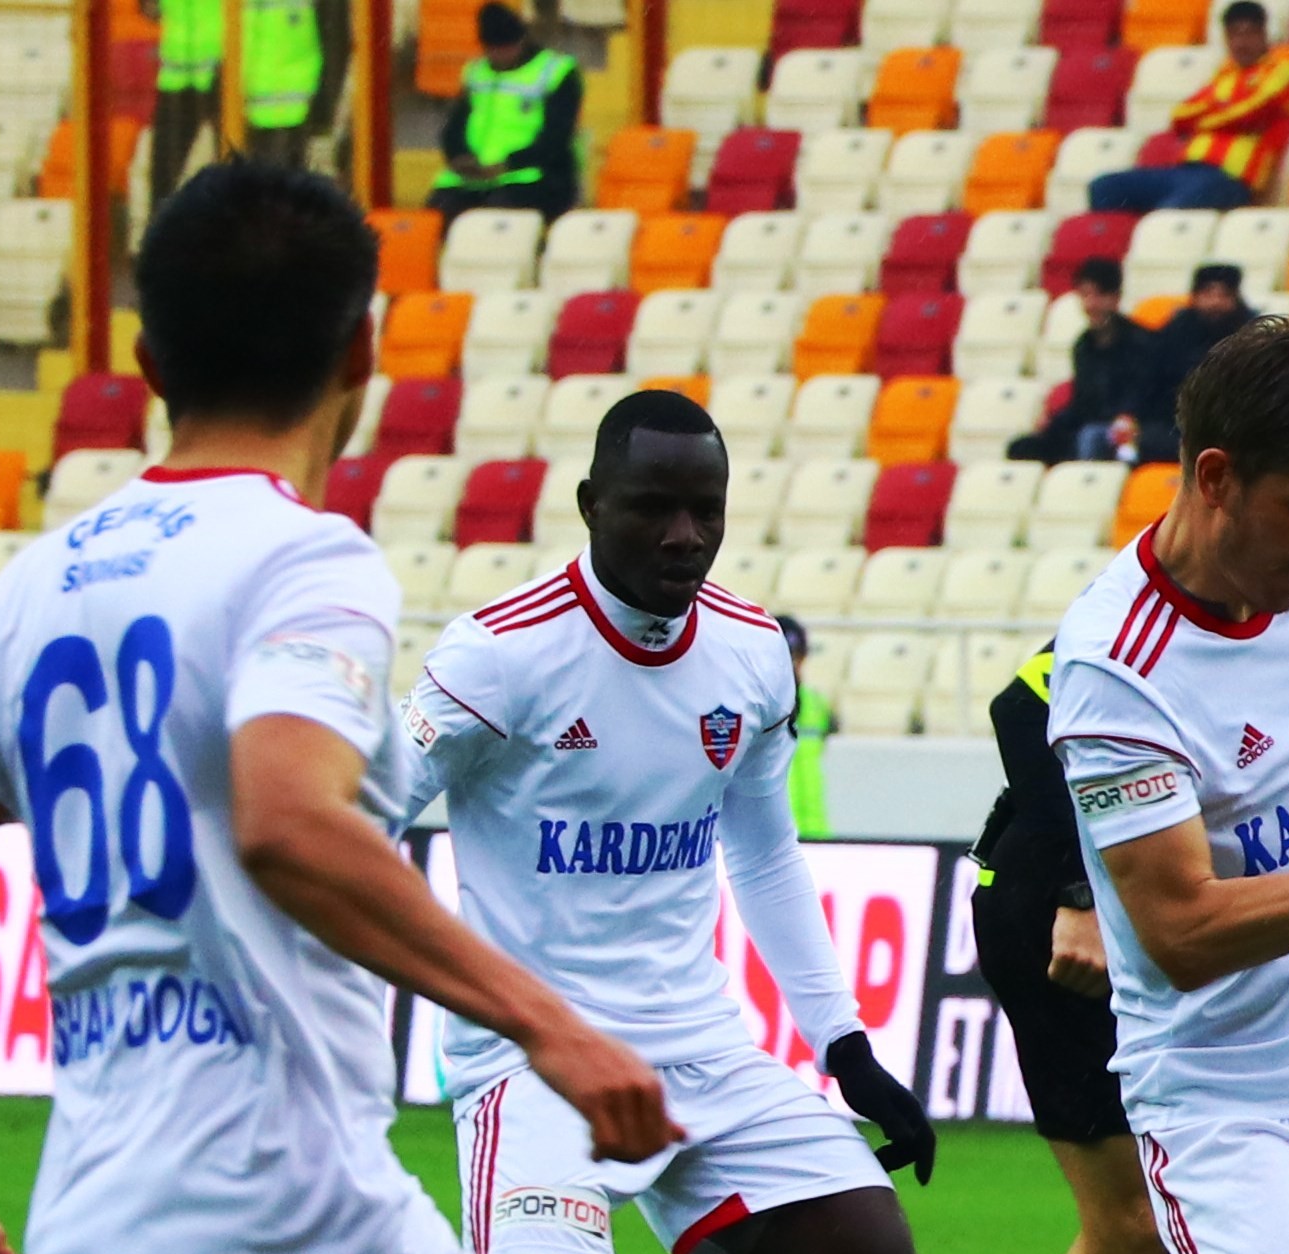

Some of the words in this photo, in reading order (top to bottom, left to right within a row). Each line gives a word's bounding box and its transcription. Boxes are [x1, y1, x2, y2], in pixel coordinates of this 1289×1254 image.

[554, 738, 598, 750] adidas
[1236, 735, 1275, 769] adidas
[19, 614, 199, 946] 68
